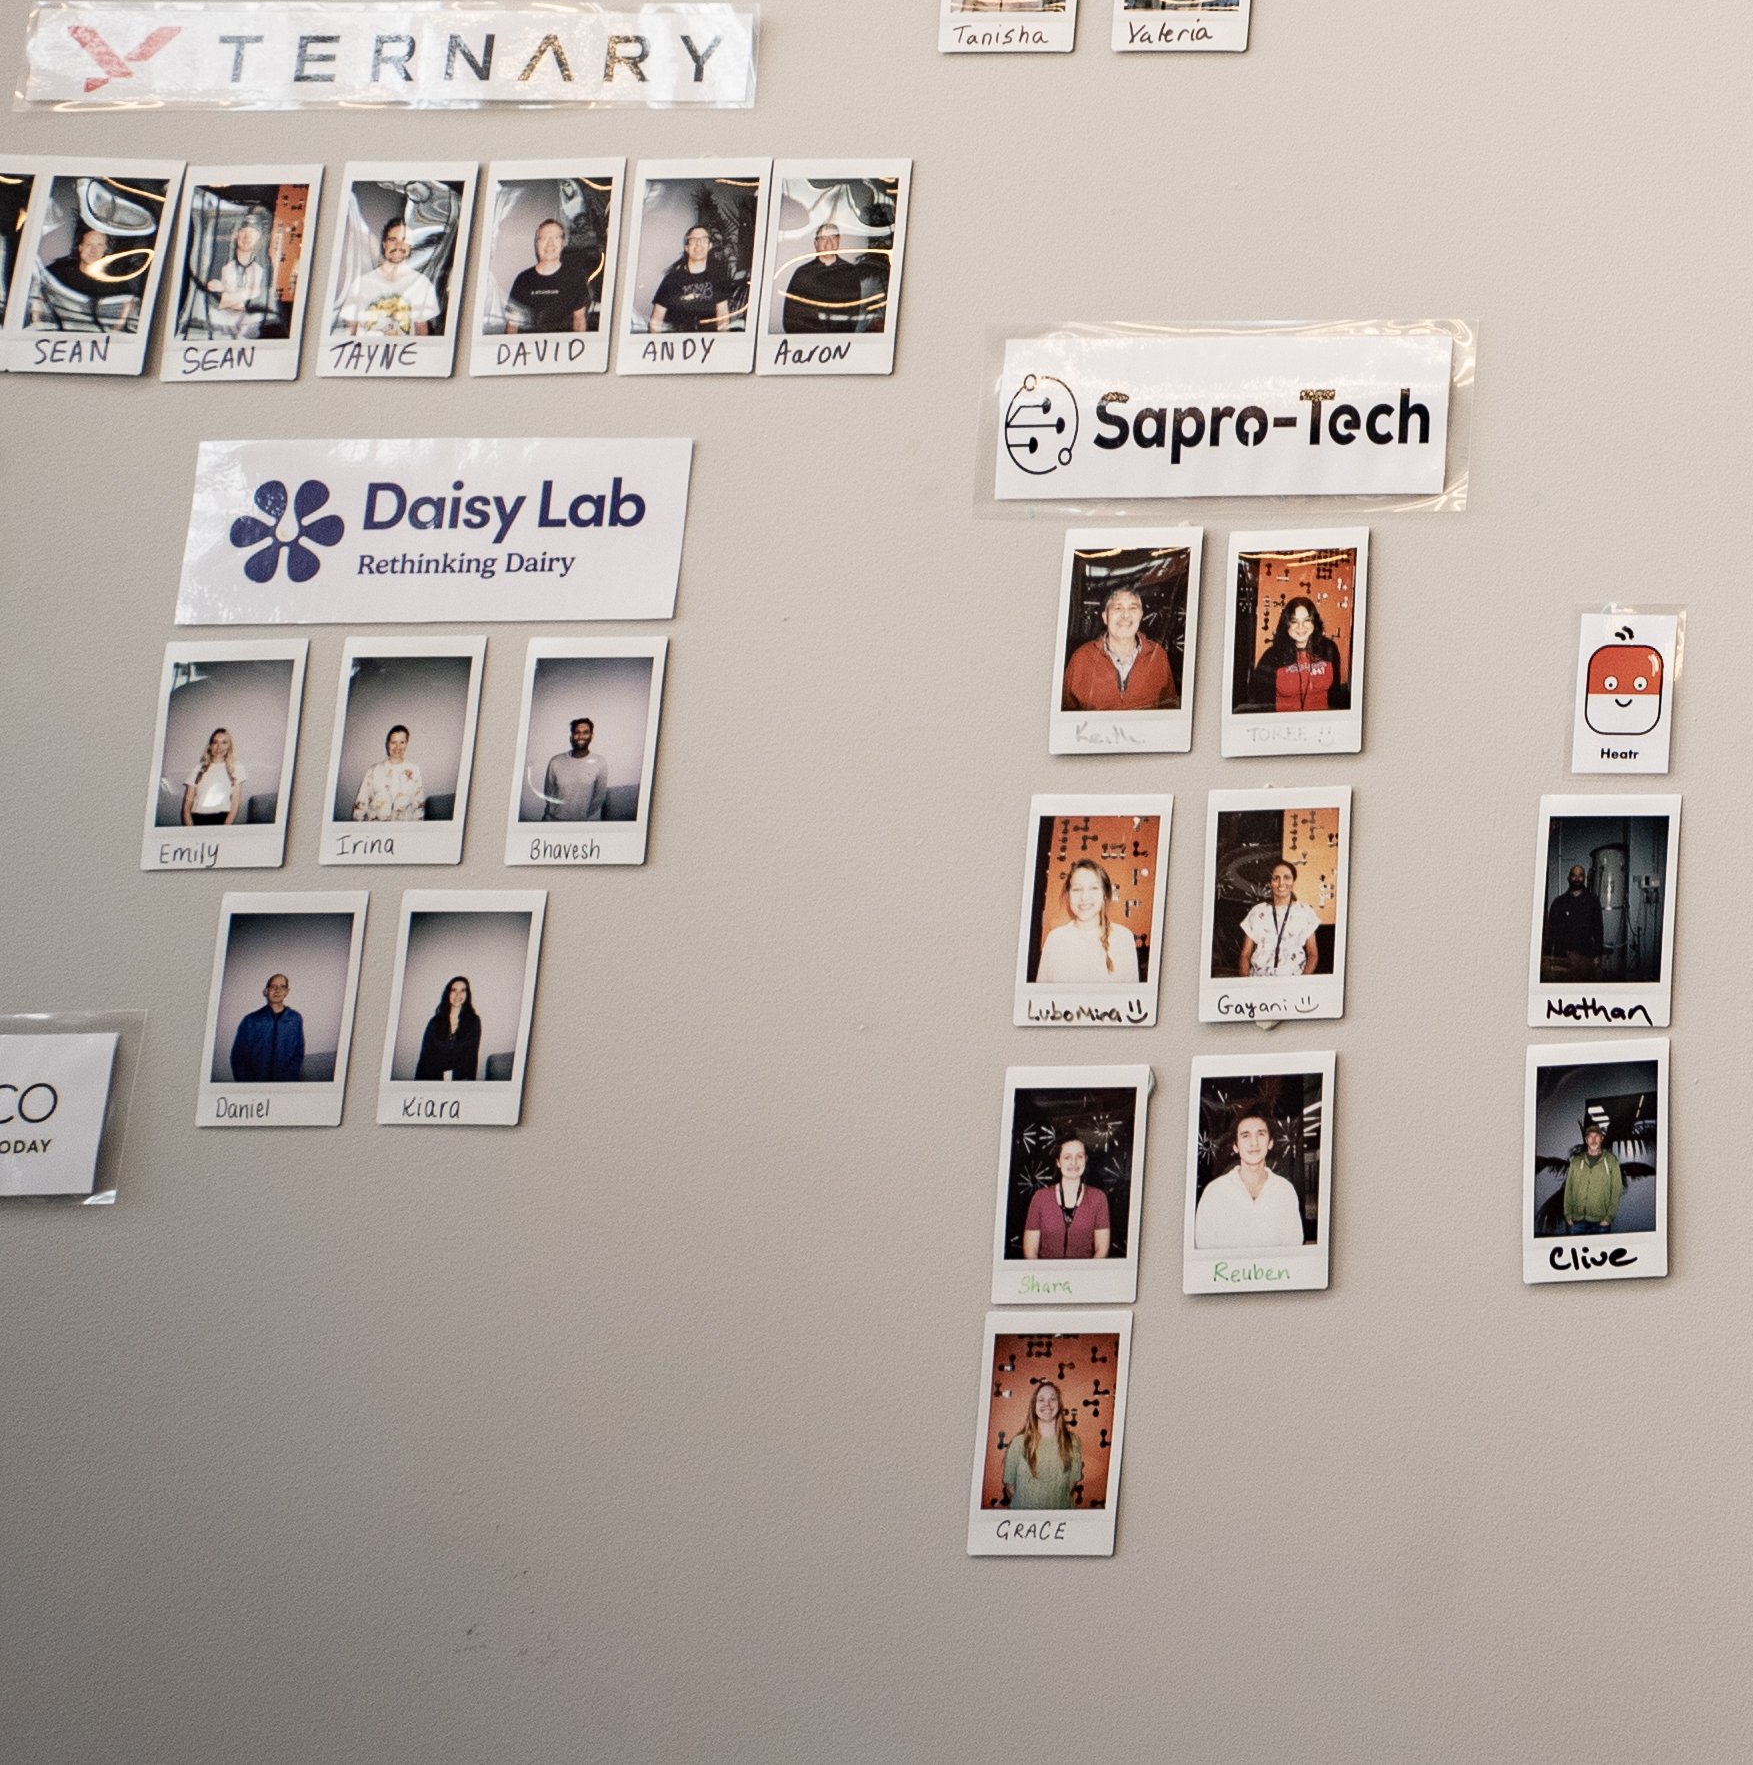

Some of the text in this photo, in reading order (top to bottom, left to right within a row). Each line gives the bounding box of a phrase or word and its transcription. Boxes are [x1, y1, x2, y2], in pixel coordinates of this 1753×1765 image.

[953, 25, 1049, 47] Tanisha
[218, 33, 724, 85] TERNARY
[33, 336, 111, 366] SEAN
[181, 346, 257, 375] SEAN
[330, 341, 419, 371] TAYNE
[496, 338, 587, 365] DAVID
[641, 336, 717, 364] ANDY
[1092, 387, 1431, 465] Sapro-Tech
[363, 476, 646, 545] Daisy Lab
[356, 550, 576, 580] Rethinking Dairy
[1600, 746, 1640, 761] Heatr
[158, 840, 221, 867] Emily
[529, 836, 602, 863] Bhavesh
[1545, 999, 1653, 1025] Nathan
[214, 1096, 271, 1121] Daniel
[401, 1097, 461, 1121] Kiara
[1548, 1244, 1638, 1272] Clive
[1213, 1261, 1291, 1284] Reuben
[995, 1519, 1067, 1542] GRACE
